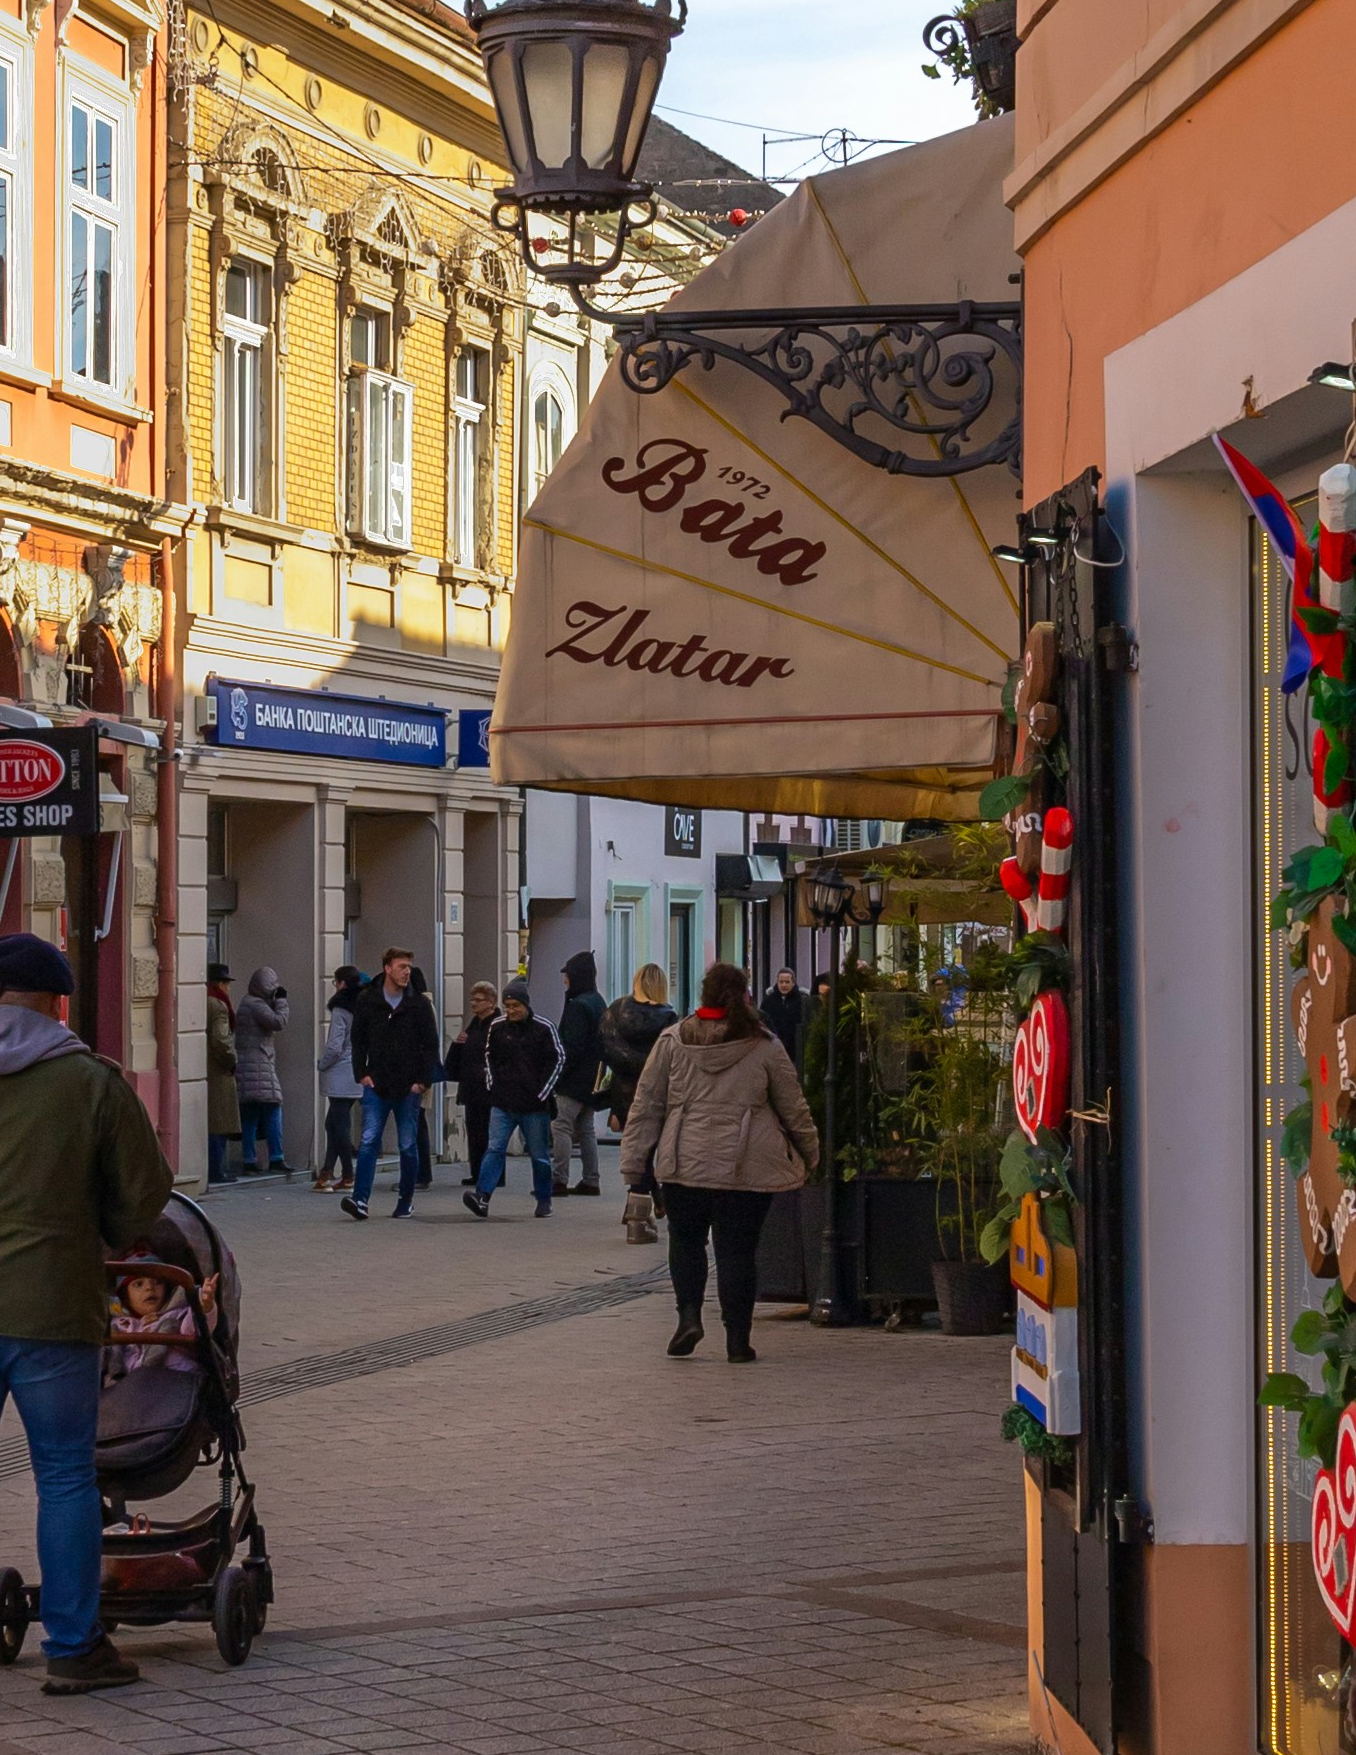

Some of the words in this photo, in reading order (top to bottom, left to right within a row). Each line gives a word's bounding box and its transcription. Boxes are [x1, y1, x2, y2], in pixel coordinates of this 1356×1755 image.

[716, 466, 771, 500] 1972
[601, 438, 827, 586] Bata
[545, 600, 795, 688] Zlatar
[254, 703, 294, 730] БАНКА
[296, 709, 366, 739] ПОШТАНСКА
[368, 718, 439, 750] ШТЕДИОНИЦА
[23, 804, 73, 826] SHOP
